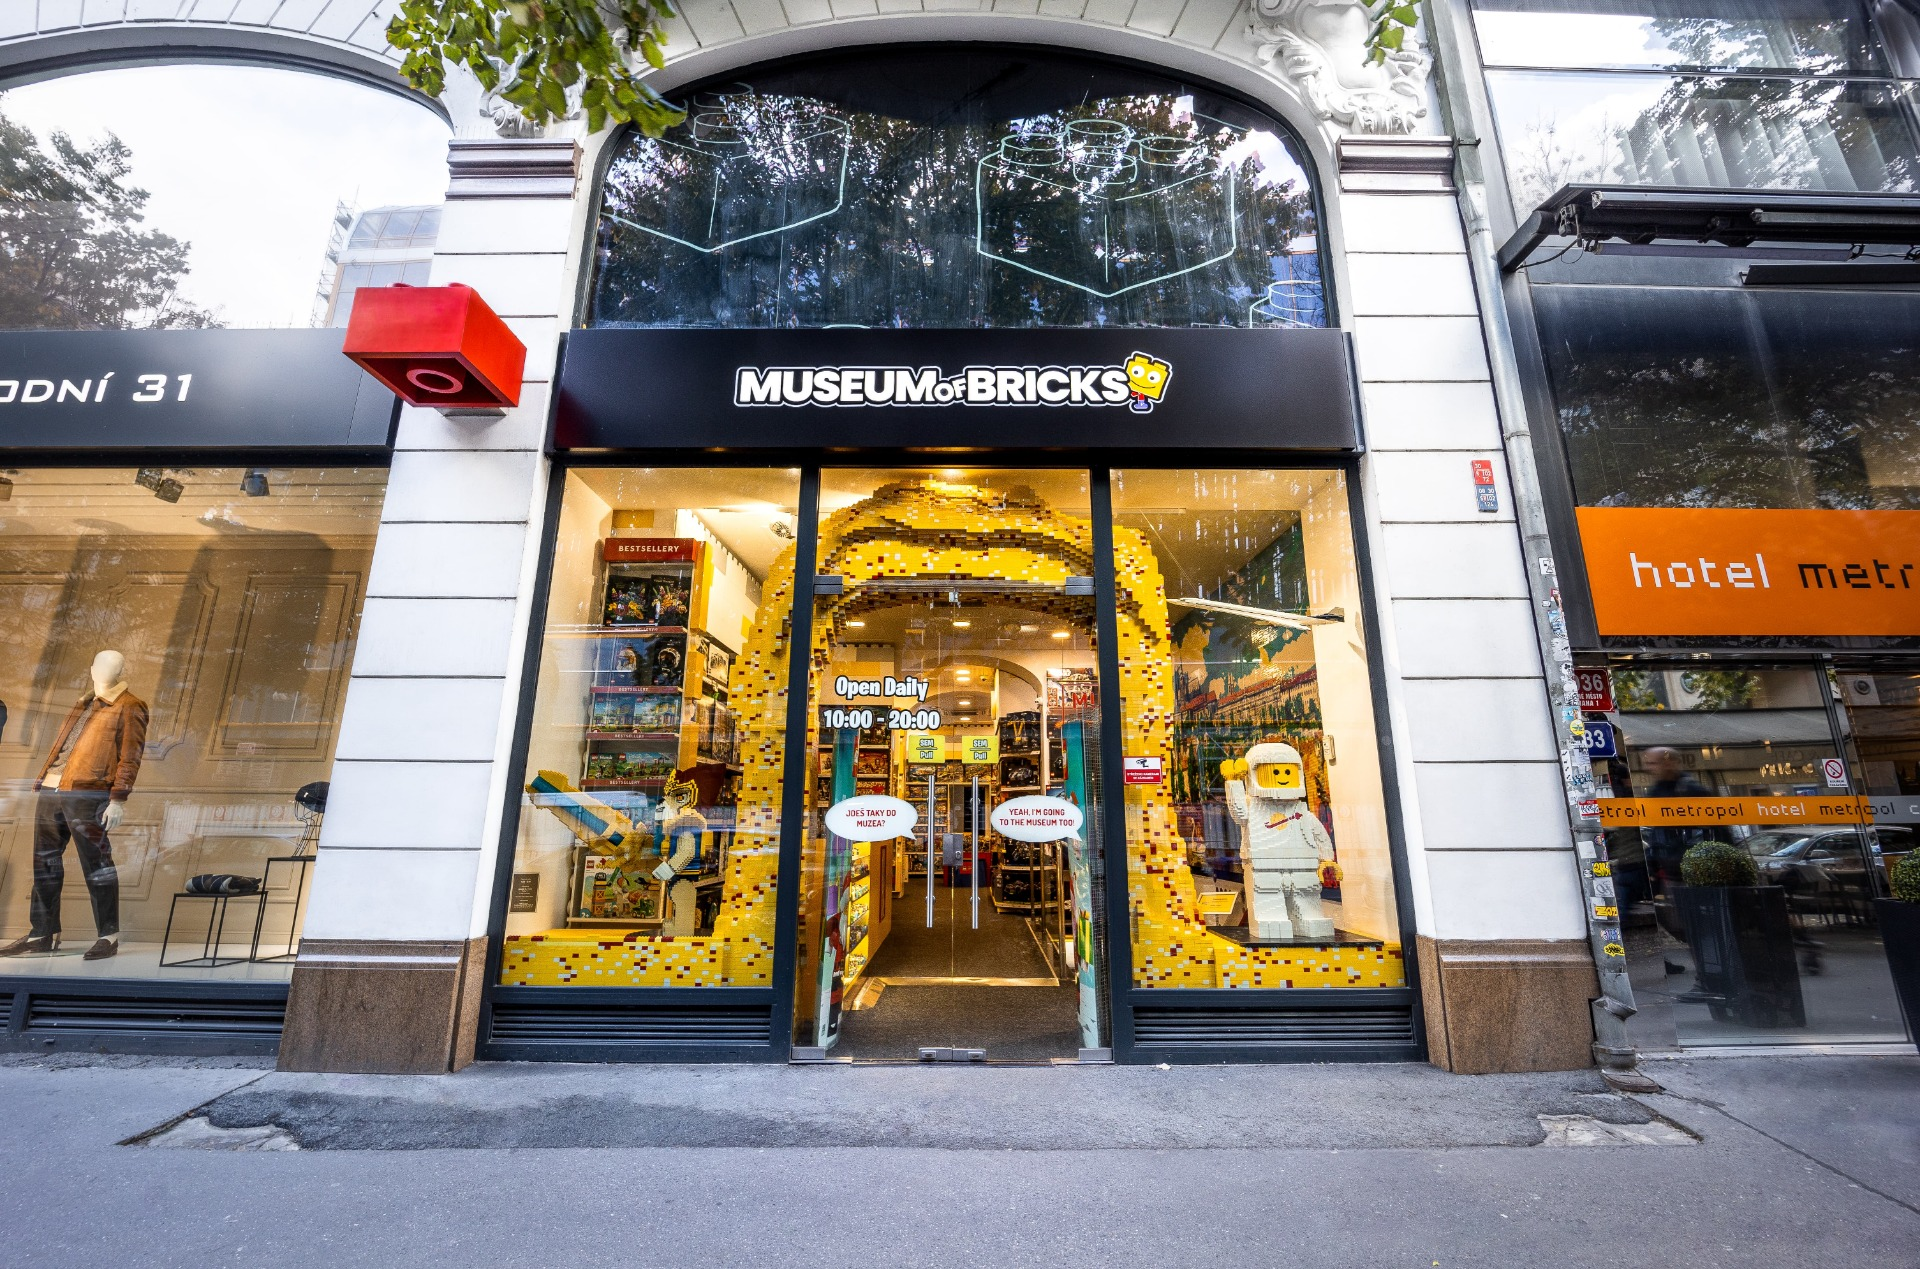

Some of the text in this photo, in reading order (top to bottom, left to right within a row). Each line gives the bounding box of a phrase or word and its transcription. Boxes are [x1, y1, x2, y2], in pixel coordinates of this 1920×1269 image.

[132, 373, 193, 402] 31
[739, 370, 936, 402] MUSEUM
[967, 369, 1131, 402] BRICKS
[618, 545, 680, 553] BESTSELLERY
[1629, 552, 1914, 588] hotel metr
[836, 676, 929, 702] Open Daily
[1585, 691, 1603, 700] MĚSTO
[823, 709, 873, 729] 10:00
[888, 709, 941, 730] 20:00
[920, 738, 934, 747] SEM
[973, 739, 988, 747] SEM
[920, 751, 934, 759] Pull
[974, 752, 988, 760] Pull
[866, 809, 885, 817] TAKY
[886, 809, 897, 817] DO
[1009, 808, 1065, 817] YEAH, I'M GOING
[1661, 803, 1744, 820] metropol
[1757, 802, 1806, 816] hotel
[856, 819, 885, 828] MUZEA?
[999, 818, 1075, 827] TO THE MUSEUM TOO!
